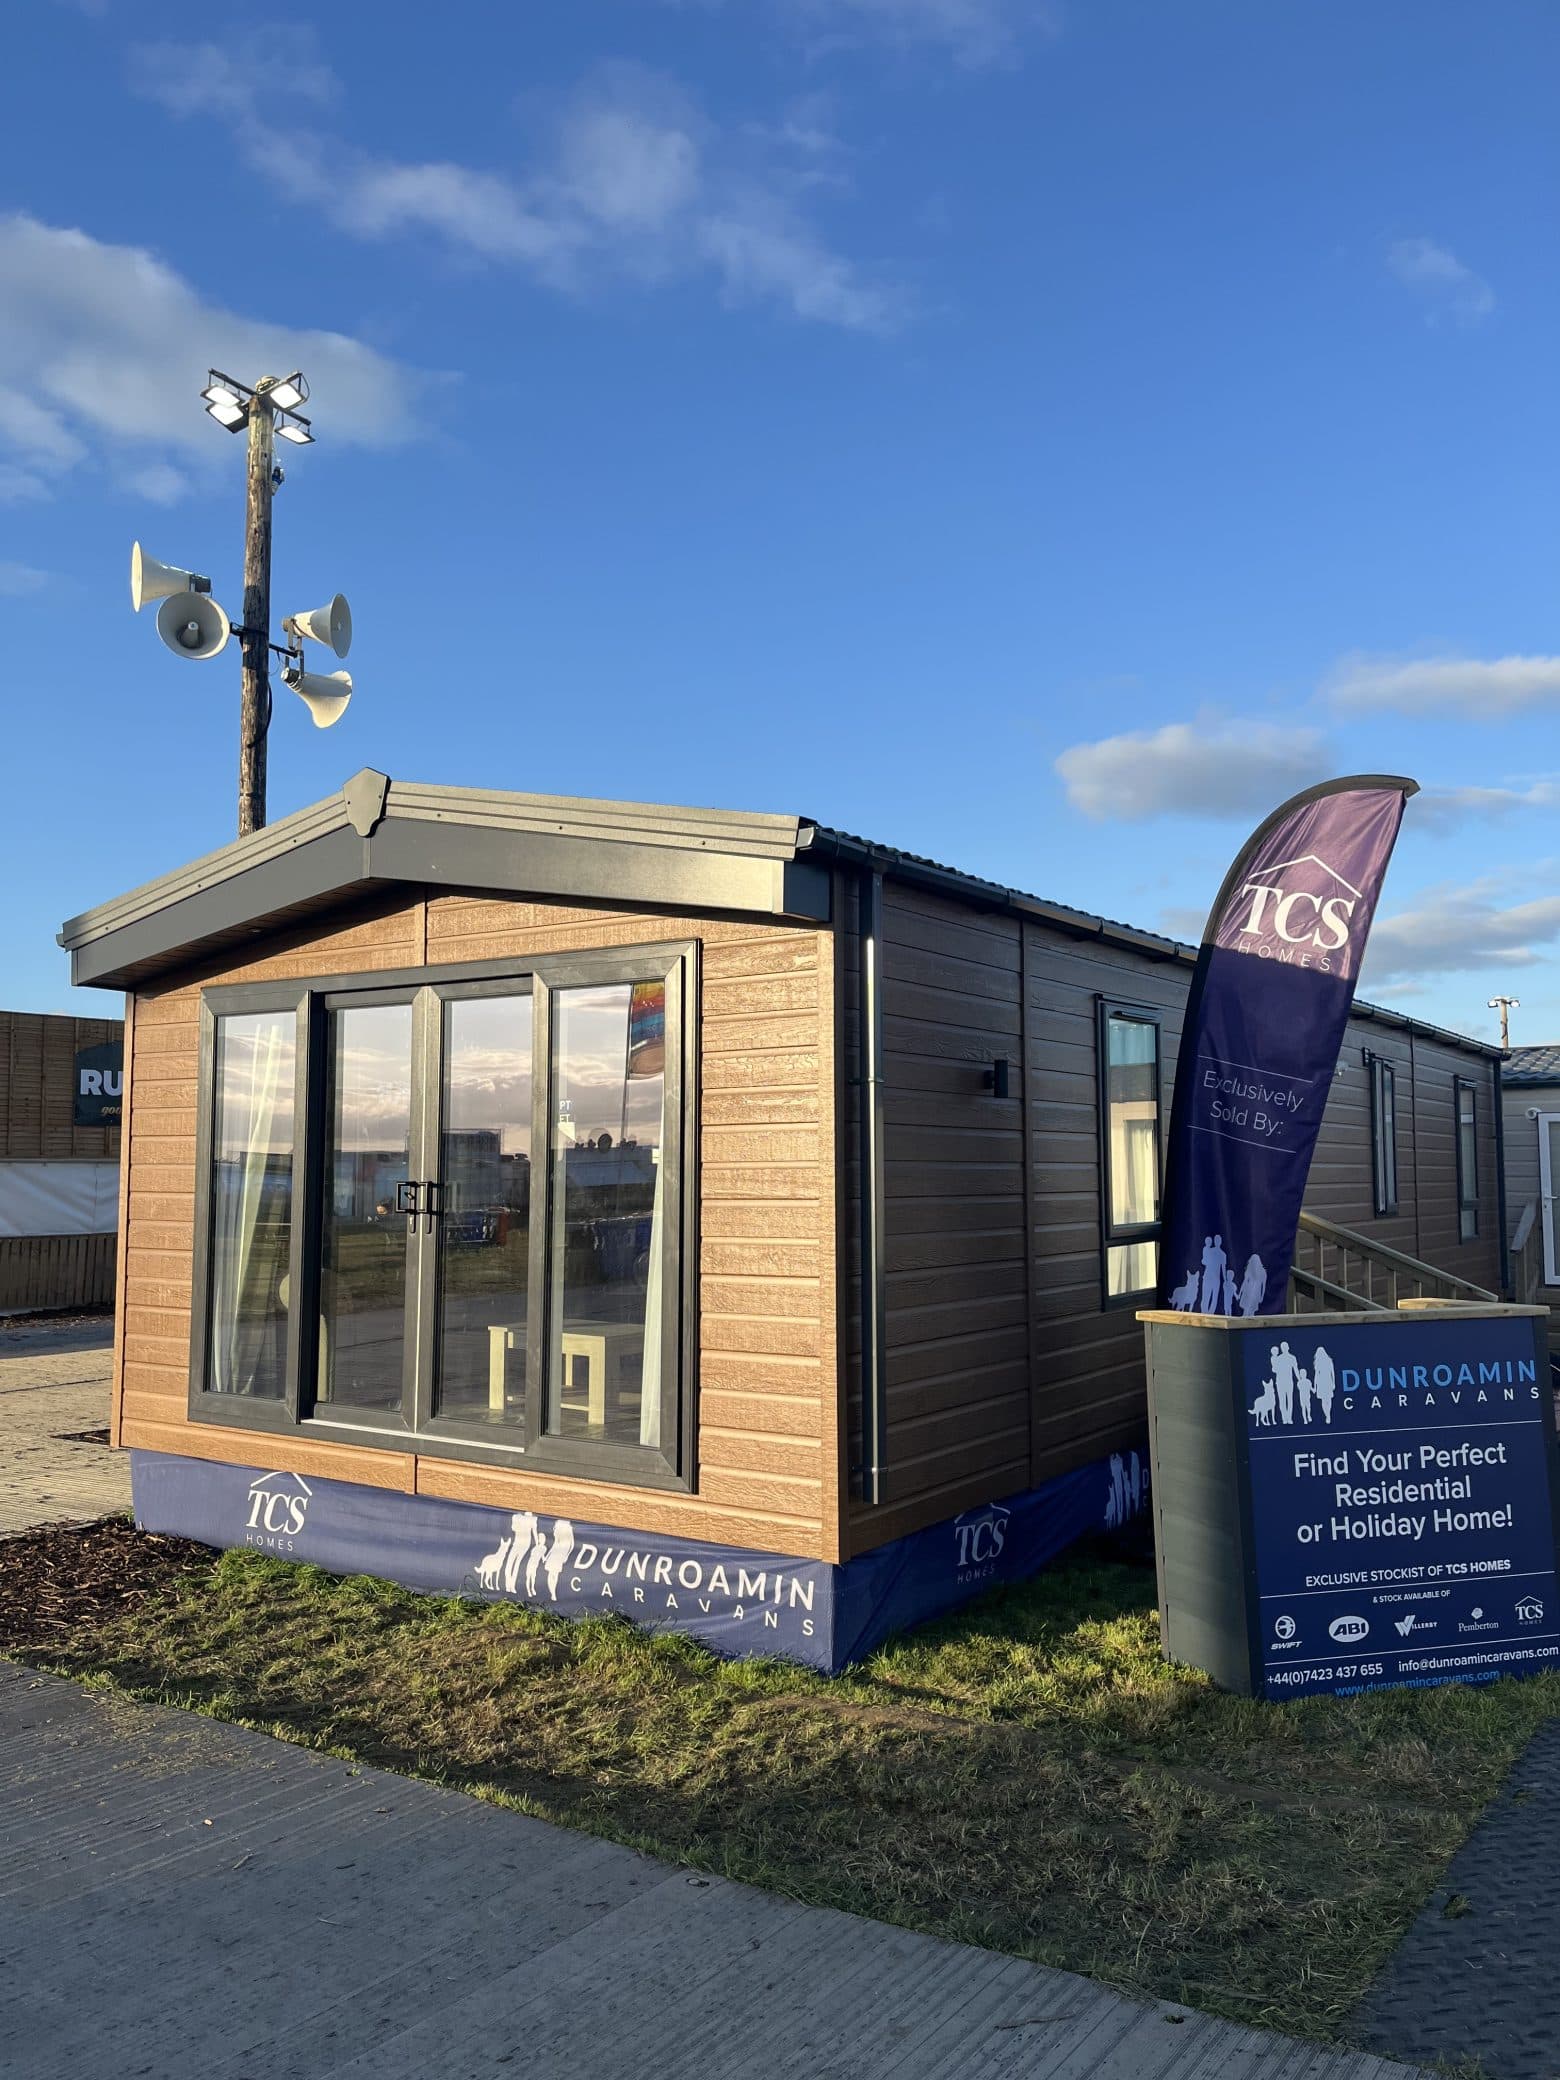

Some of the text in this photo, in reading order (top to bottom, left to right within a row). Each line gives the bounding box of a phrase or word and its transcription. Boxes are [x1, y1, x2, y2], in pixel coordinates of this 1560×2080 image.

[1240, 884, 1355, 950] TCS
[1238, 941, 1331, 971] HOMES
[1203, 1070, 1304, 1113] Exclusively
[1210, 1101, 1284, 1137] Sold By:
[1342, 1360, 1536, 1392] DUNROAMIN
[1343, 1387, 1540, 1410] CARAVANS
[1294, 1443, 1507, 1477] Find Your Perfect
[1335, 1475, 1471, 1507] Residential
[246, 1490, 308, 1535] TCS
[1297, 1504, 1513, 1543] or Holiday Home!
[246, 1533, 293, 1551] HOMES
[955, 1518, 1008, 1567] TCS
[574, 1544, 814, 1610] DUNROAMIN
[1305, 1559, 1511, 1587] EXCLUSIVE STOCKIST OF TCS HOMES
[571, 1577, 814, 1636] CARAVANS
[1372, 1589, 1451, 1604] & STOCK AVAILABLE OF
[1458, 1621, 1500, 1633] Pemberton
[1515, 1604, 1544, 1621] TCS
[1333, 1622, 1366, 1637] ABI
[1271, 1641, 1303, 1650] SWIFT
[1398, 1646, 1559, 1673] info@dunroamincaravans.com
[1267, 1663, 1383, 1686] +44(0)7423 437 655
